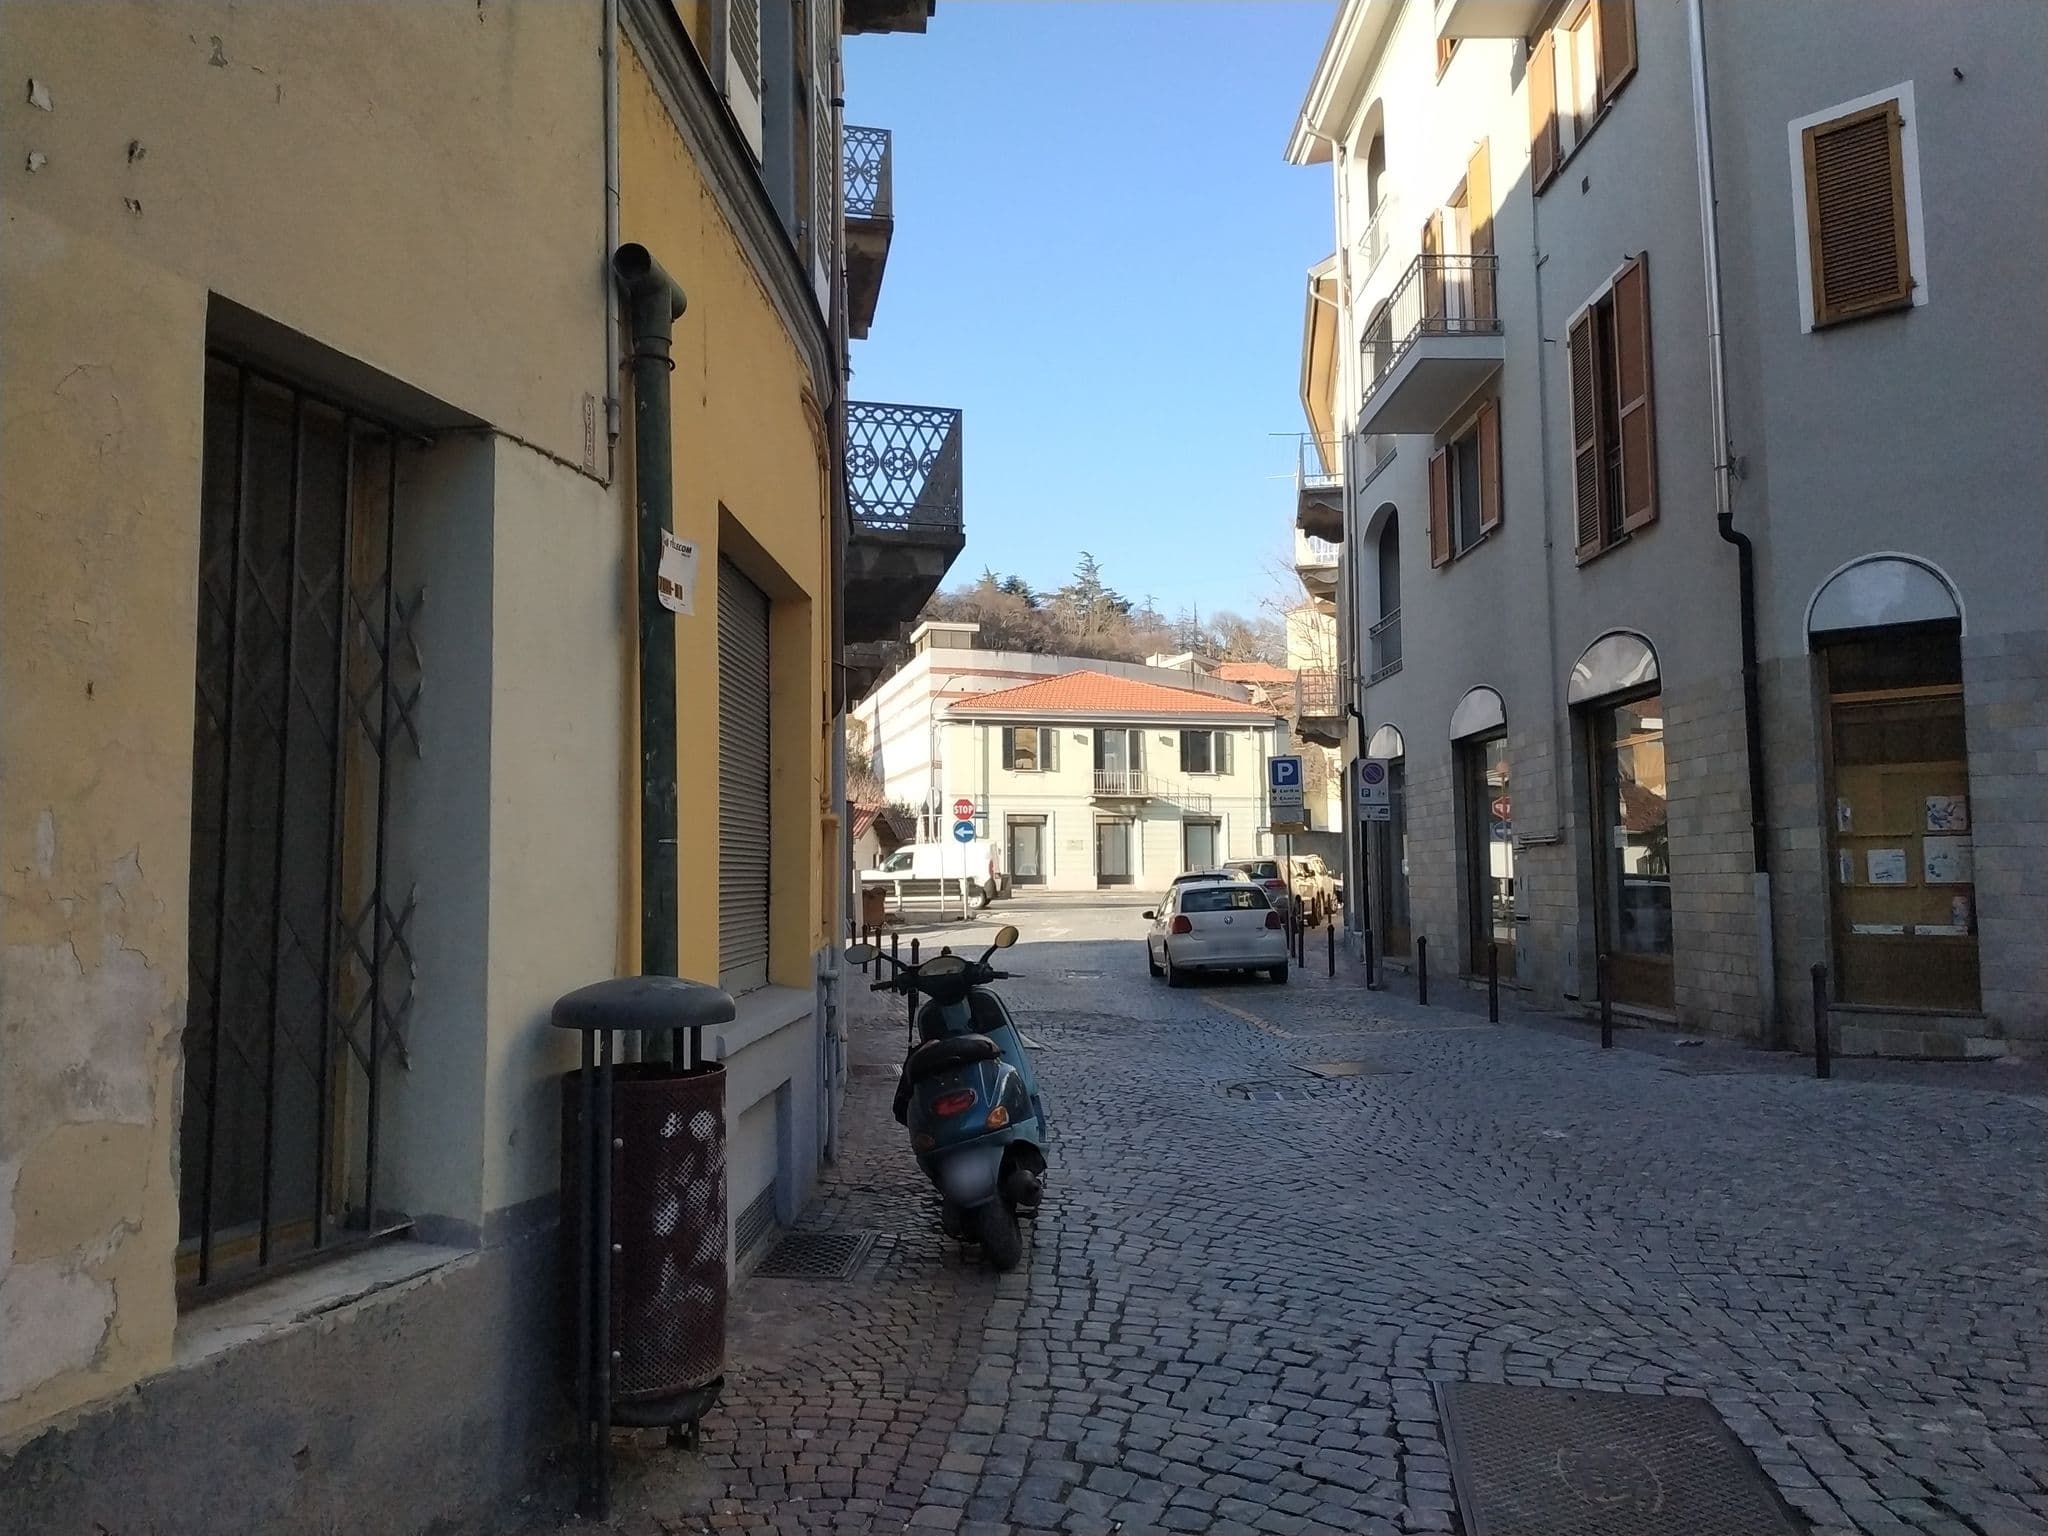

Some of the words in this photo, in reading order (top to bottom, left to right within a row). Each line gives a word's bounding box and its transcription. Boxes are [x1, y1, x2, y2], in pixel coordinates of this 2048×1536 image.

[670, 540, 692, 553] TELECOM
[1277, 762, 1294, 783] P
[954, 805, 974, 814] STOP
